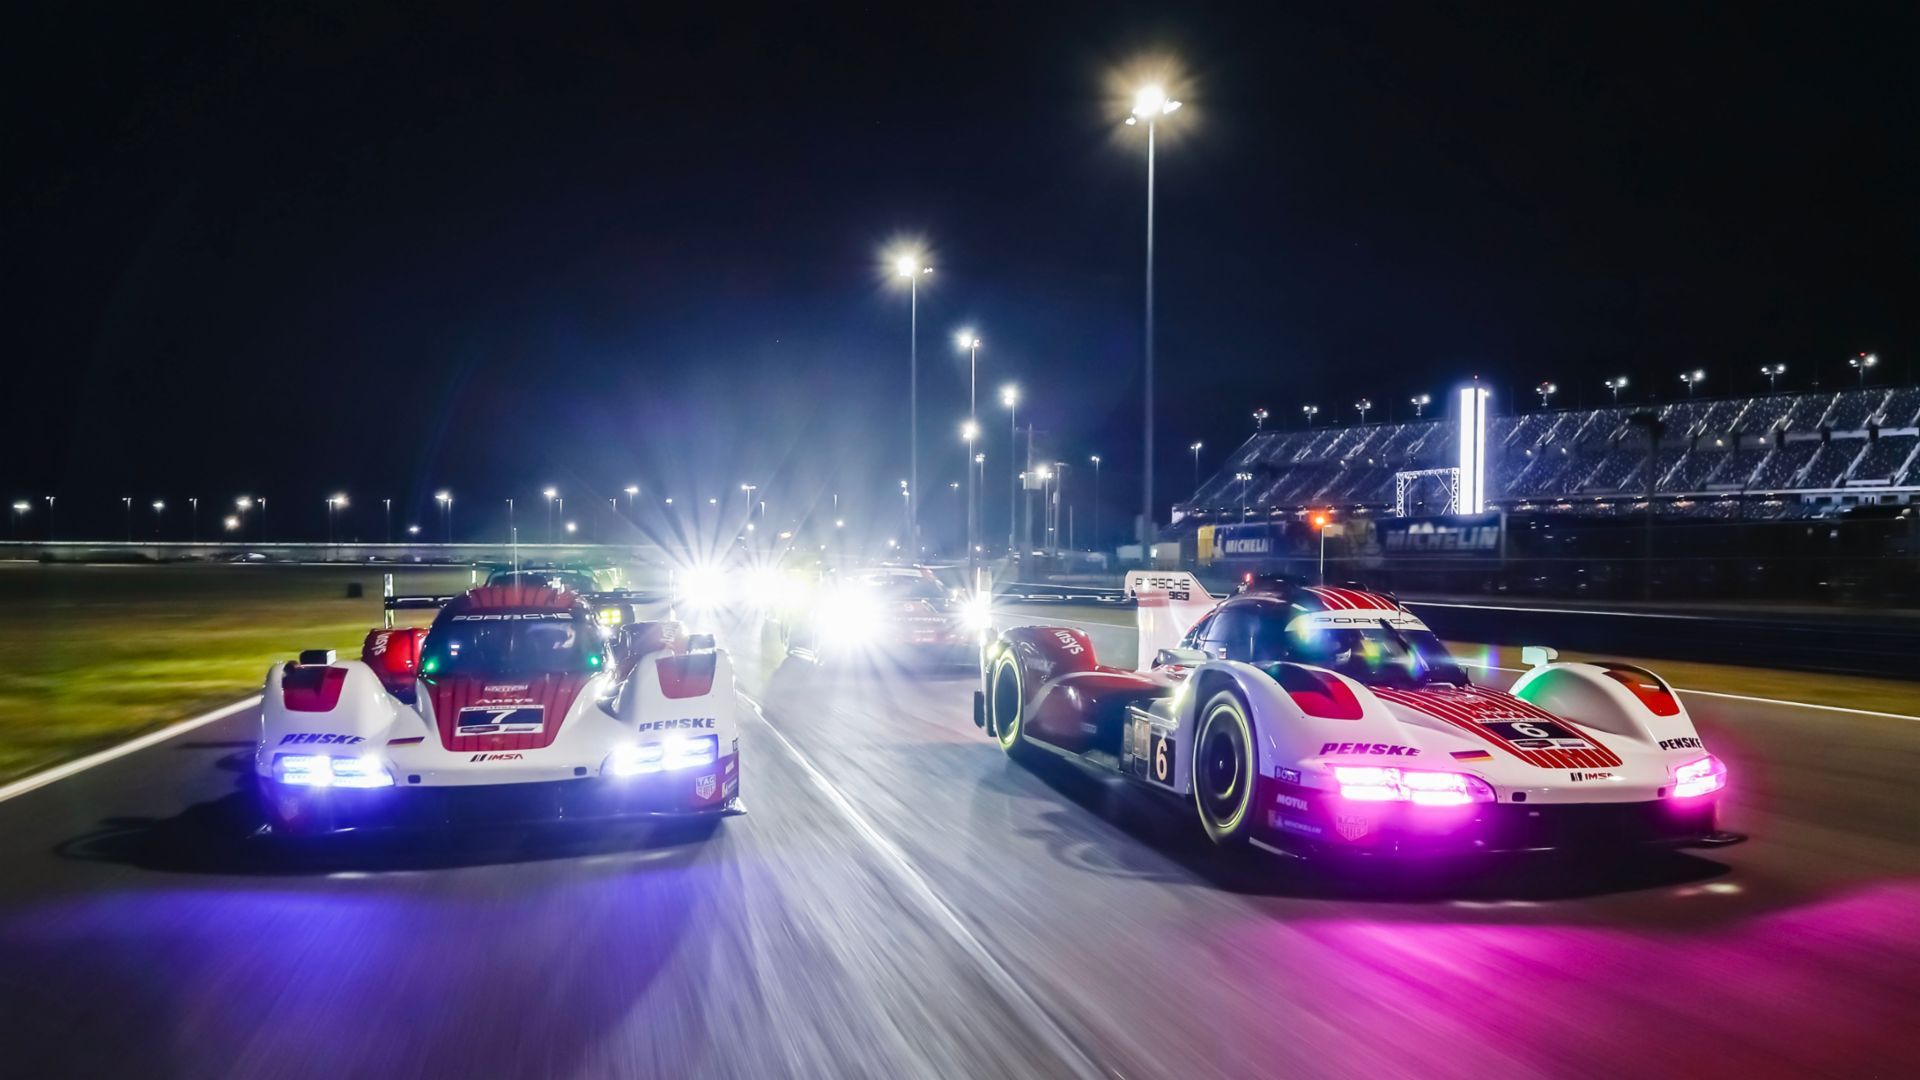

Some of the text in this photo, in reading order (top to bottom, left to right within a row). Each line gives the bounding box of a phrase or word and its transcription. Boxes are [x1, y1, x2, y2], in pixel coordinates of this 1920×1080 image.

[1136, 578, 1190, 590] PRSCHE
[1169, 591, 1190, 601] 963
[452, 613, 574, 621] PORSCHE
[486, 709, 518, 724] 7
[639, 718, 716, 732] PENSKE
[1511, 723, 1549, 738] 6
[1319, 742, 1421, 756] PENSKE
[1156, 738, 1168, 781] 6
[1276, 794, 1309, 811] MOTUL
